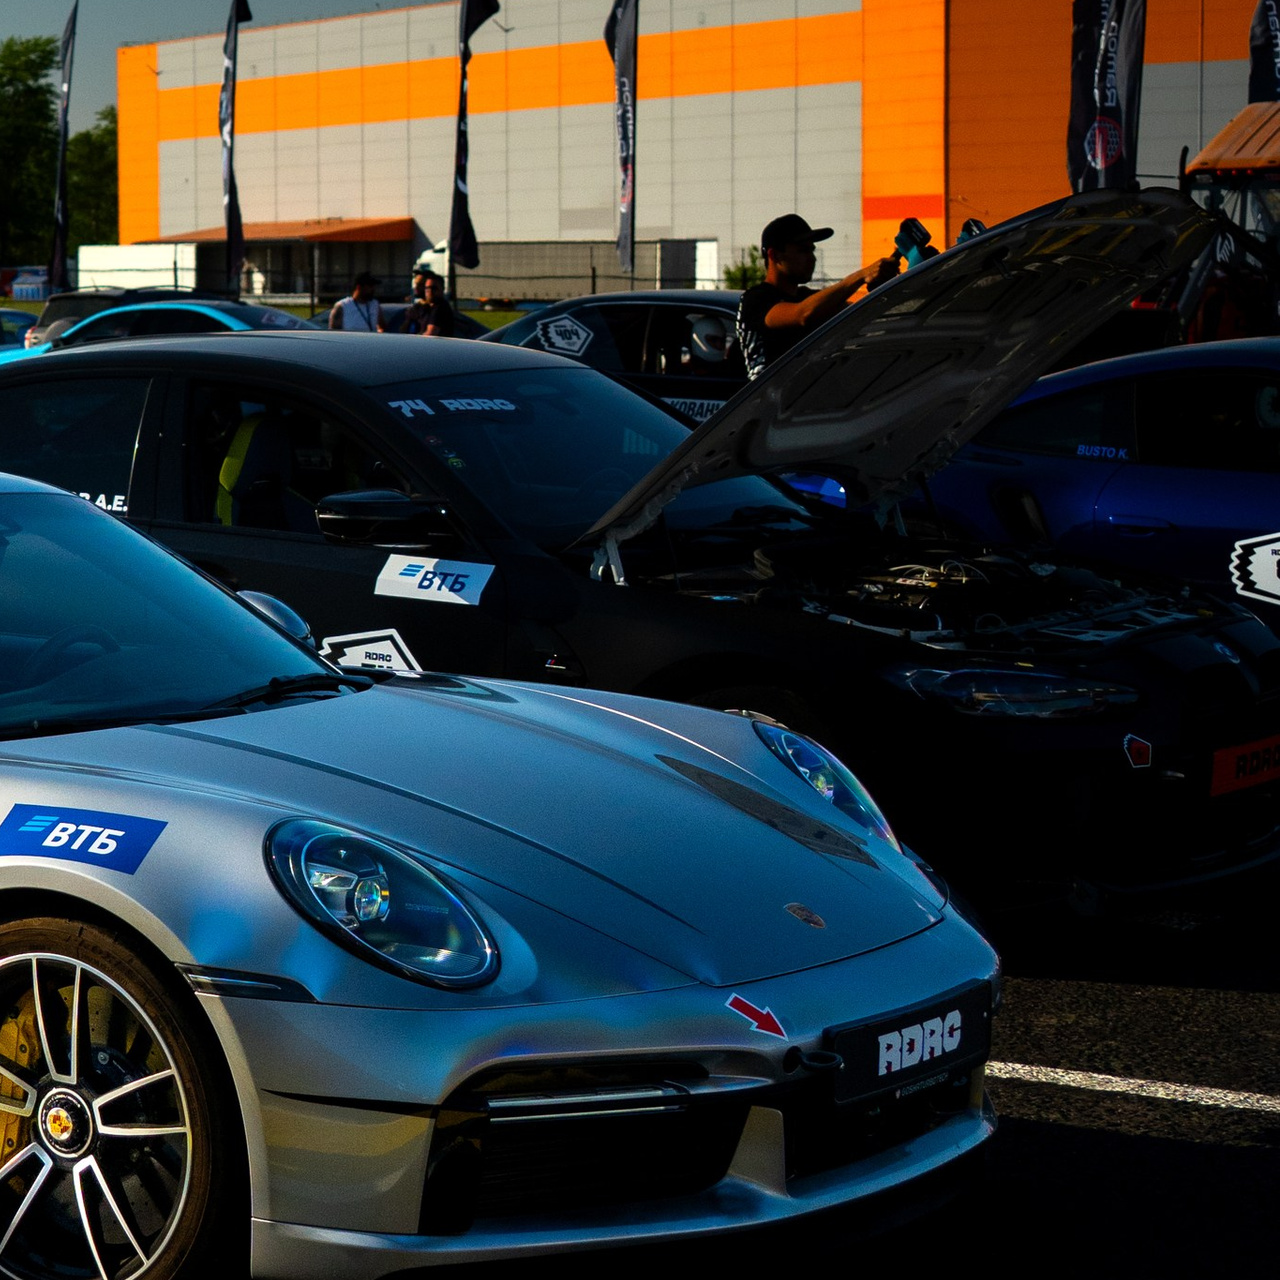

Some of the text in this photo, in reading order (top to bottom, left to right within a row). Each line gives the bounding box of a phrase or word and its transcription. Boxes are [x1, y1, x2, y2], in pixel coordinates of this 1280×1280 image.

[554, 328, 581, 341] 404
[387, 398, 436, 418] 74
[1076, 444, 1116, 458] BUSTO
[417, 570, 470, 593] ВТБ
[364, 651, 392, 663] RDRC
[42, 822, 126, 855] ВТБ
[877, 1009, 962, 1077] RDRC
